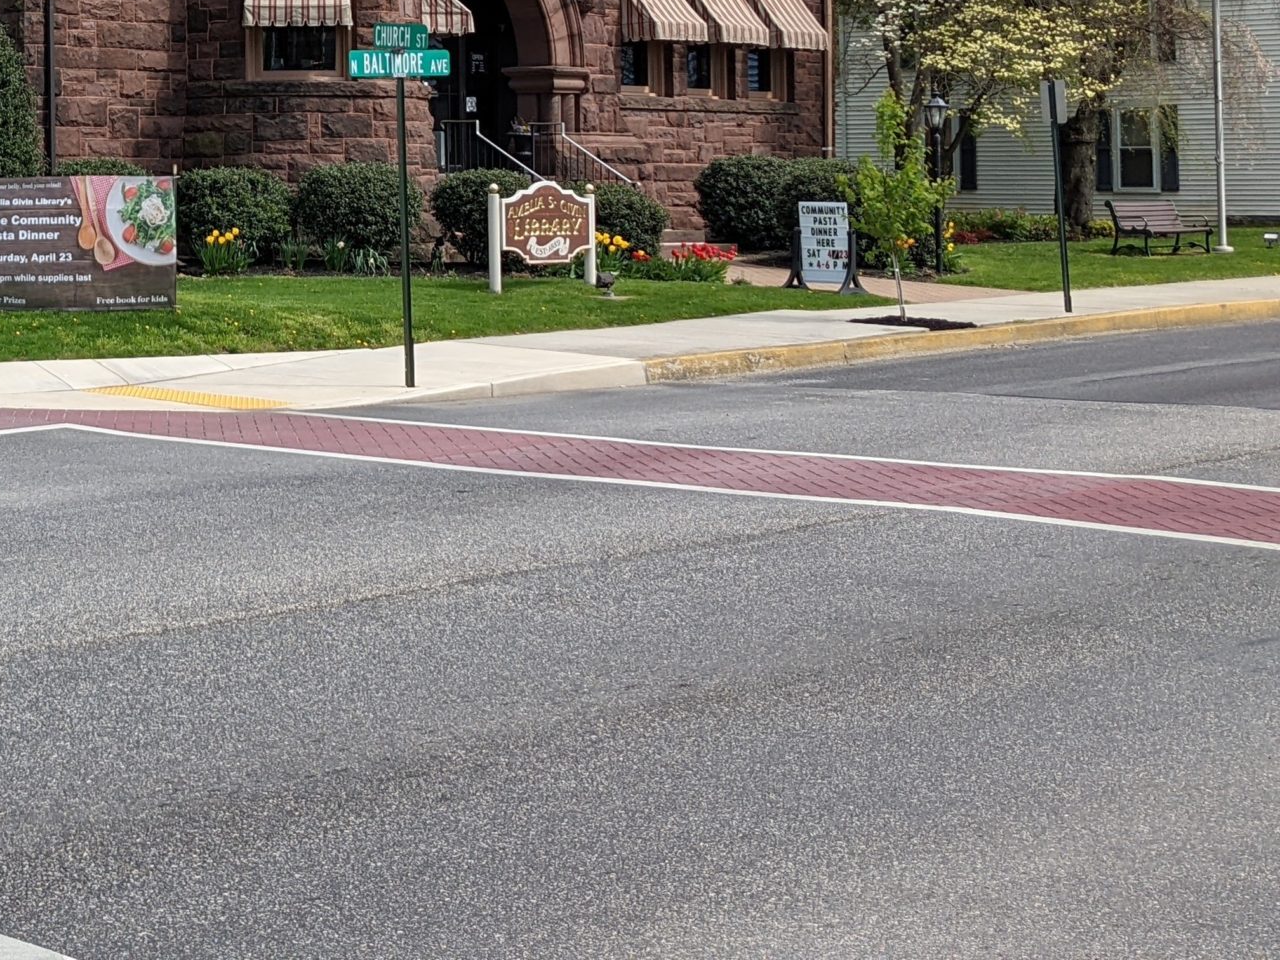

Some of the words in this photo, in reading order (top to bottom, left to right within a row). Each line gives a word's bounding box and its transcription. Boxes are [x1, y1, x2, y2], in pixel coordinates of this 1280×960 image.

[375, 25, 411, 48] CHURCH
[416, 33, 426, 48] ST
[351, 59, 358, 74] N
[363, 52, 424, 74] BALTIMORE
[430, 59, 448, 73] AVE
[12, 197, 33, 206] Givin
[35, 197, 72, 207] Library's
[507, 196, 545, 218] AMELIA
[560, 199, 587, 218] GIVIN
[801, 205, 846, 215] COMMUNITY
[11, 214, 82, 227] Community
[813, 216, 838, 226] PASTA
[513, 218, 583, 240] LIBRARY
[810, 227, 838, 237] DINNER
[18, 229, 60, 241] Dinner
[816, 238, 836, 248] HERE
[31, 252, 56, 263] April
[58, 252, 72, 262] 23
[807, 249, 821, 258] SAT
[816, 260, 830, 269] 4-6
[0, 274, 12, 283] pm
[13, 273, 36, 282] while
[37, 273, 74, 283] supplies
[75, 273, 92, 282] last
[3, 296, 26, 305] Prizes
[96, 296, 115, 305] Free
[116, 295, 136, 304] book
[137, 295, 150, 303] for
[151, 294, 168, 303] kids
